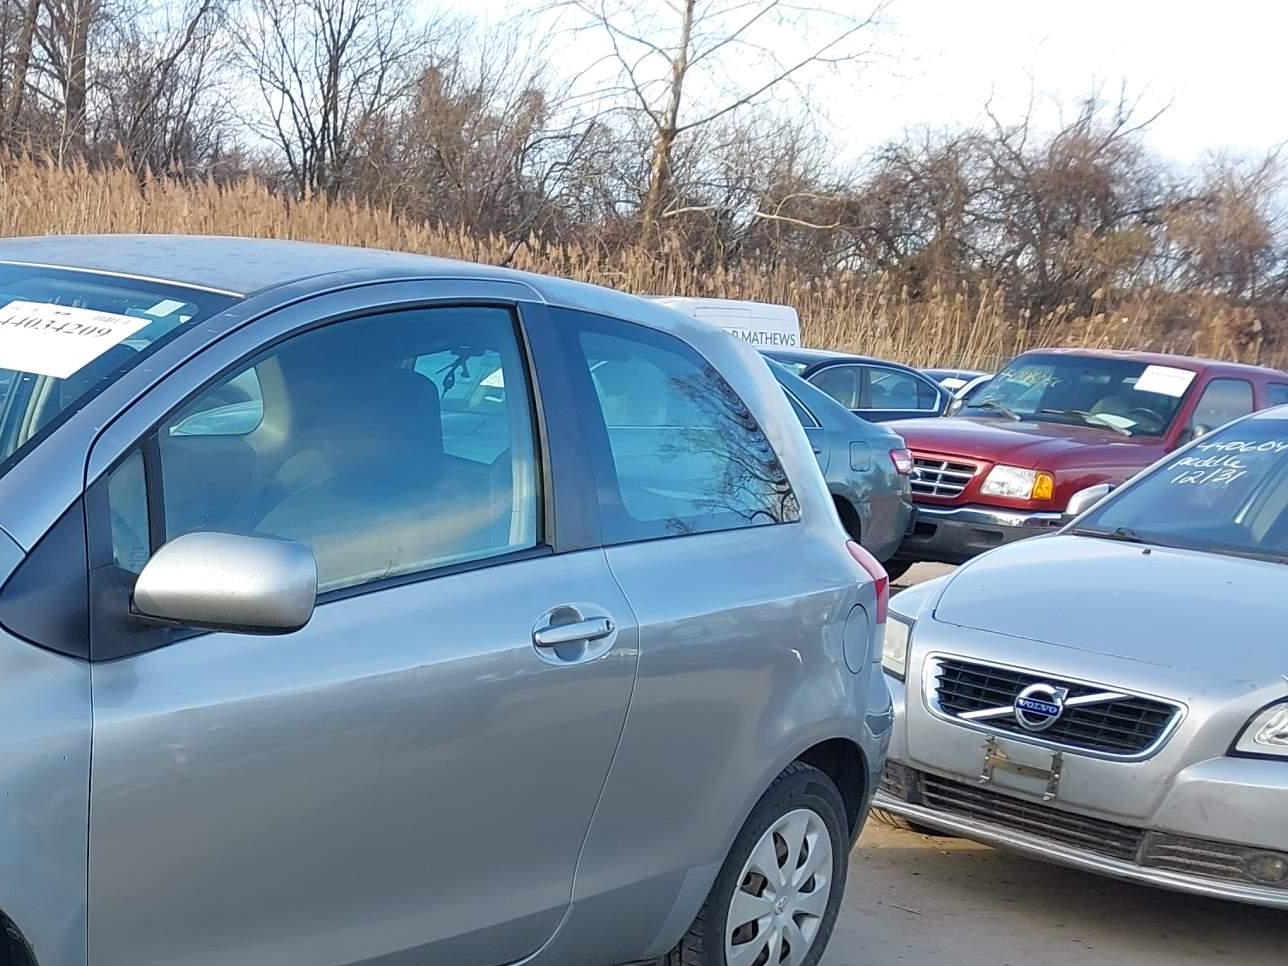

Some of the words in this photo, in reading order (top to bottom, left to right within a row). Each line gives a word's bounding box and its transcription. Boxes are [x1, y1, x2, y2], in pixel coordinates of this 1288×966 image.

[742, 330, 796, 346] MATHEWS
[1170, 468, 1248, 484] 12/31
[1018, 699, 1058, 713] VOLVO
